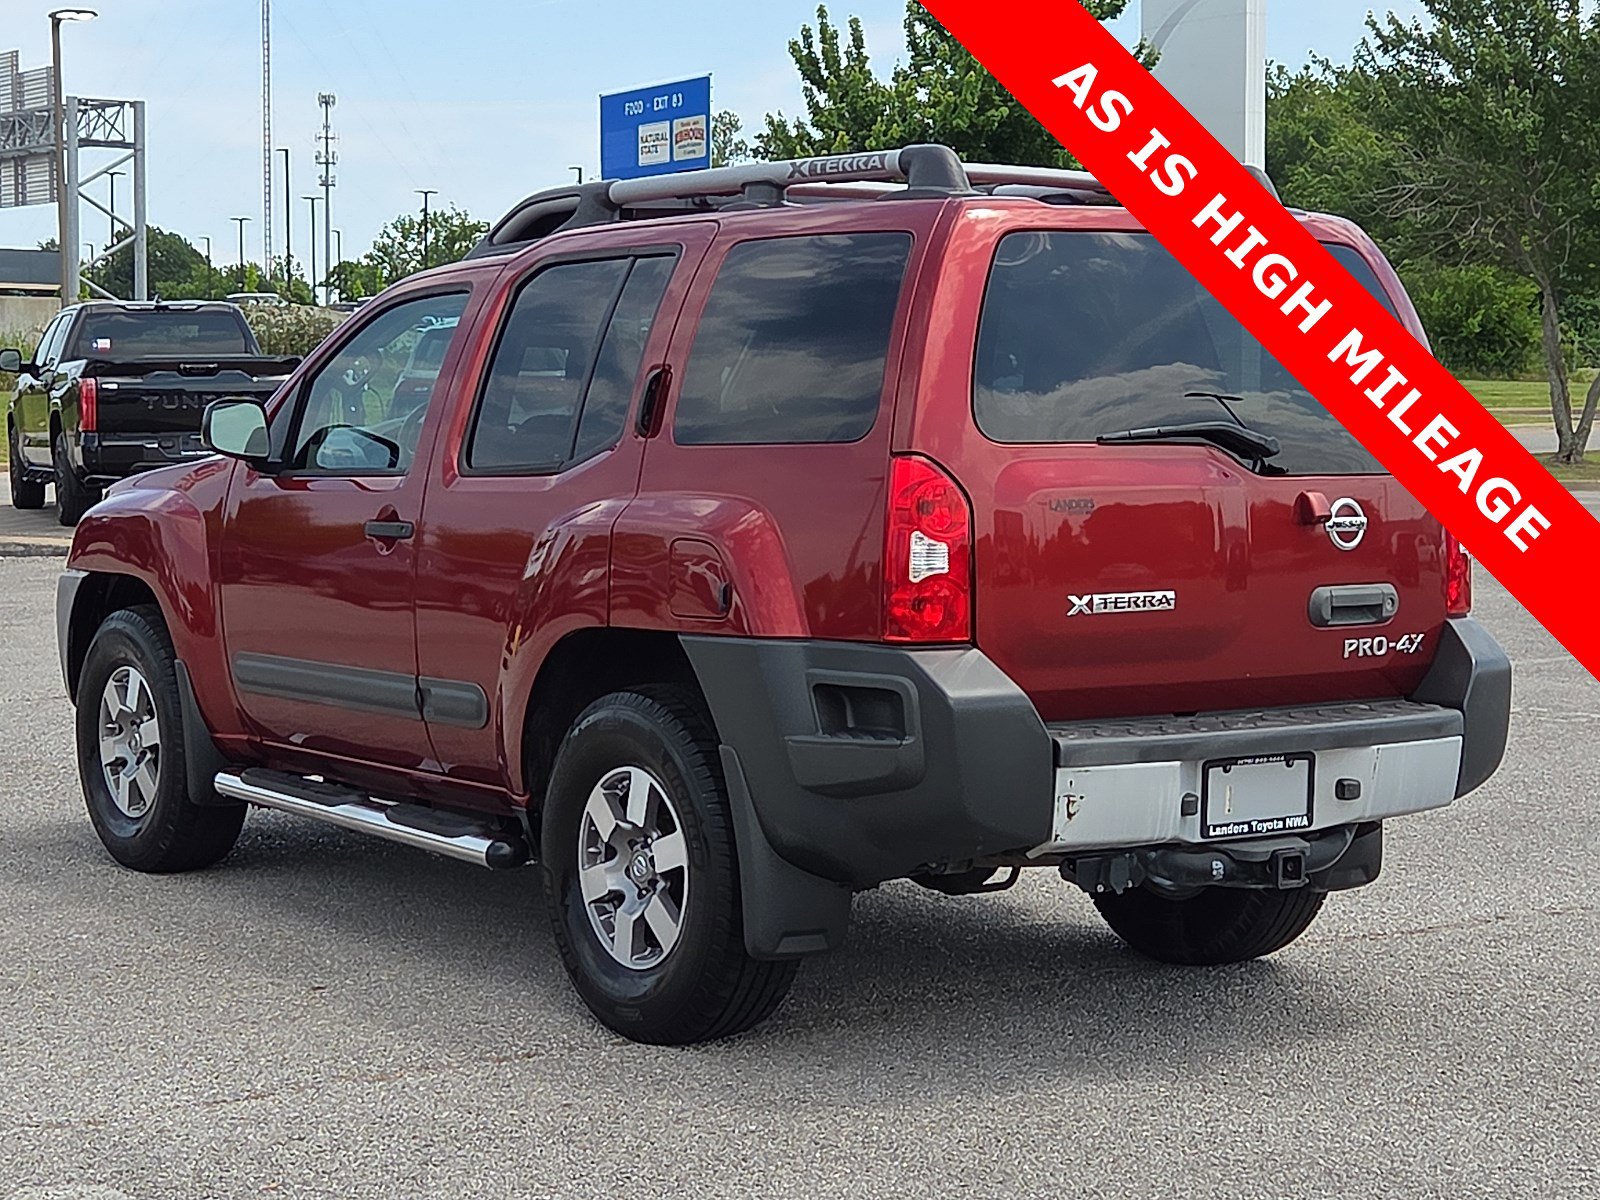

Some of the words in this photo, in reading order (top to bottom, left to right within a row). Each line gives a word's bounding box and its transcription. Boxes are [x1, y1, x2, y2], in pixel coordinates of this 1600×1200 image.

[624, 100, 644, 116] FOOD
[653, 95, 669, 111] EXIT
[640, 131, 669, 144] NATURAL
[640, 144, 659, 156] STATE
[787, 155, 883, 179] XTERRA
[141, 394, 218, 410] TUND
[1067, 591, 1175, 616] XTERRA
[1343, 633, 1425, 659] PRO-4X
[1209, 823, 1249, 837] Landers
[1251, 819, 1284, 833] Toyota
[1285, 815, 1309, 828] NWA
